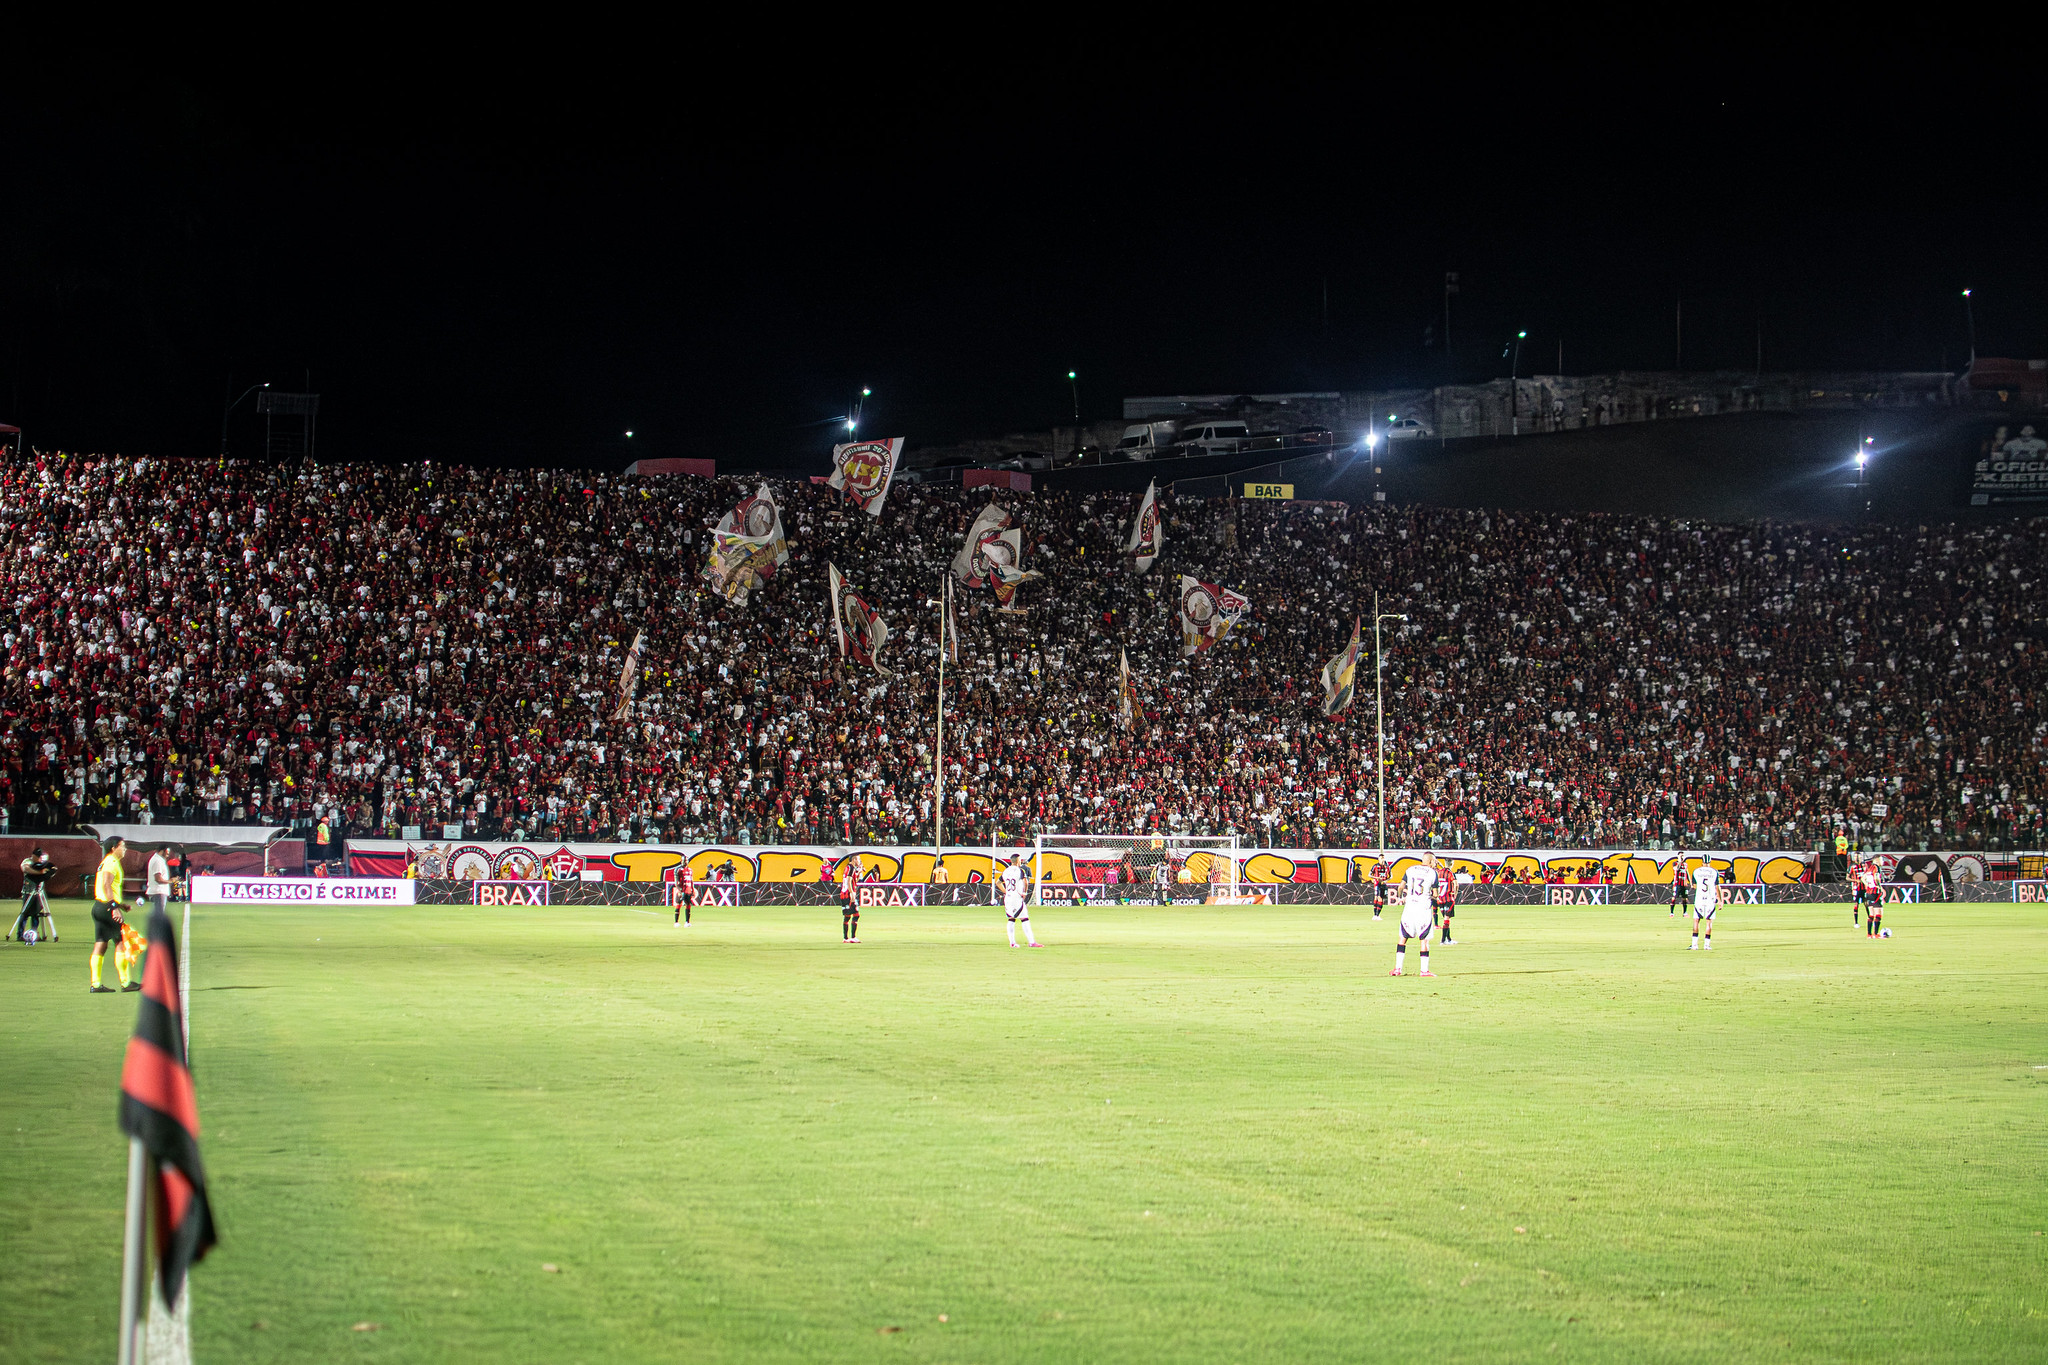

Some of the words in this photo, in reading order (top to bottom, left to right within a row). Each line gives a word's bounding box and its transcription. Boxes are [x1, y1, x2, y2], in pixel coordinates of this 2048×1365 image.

[1993, 461, 2048, 472] OFICI
[1255, 485, 1282, 497] BAR
[222, 883, 311, 899] RACISMO
[316, 882, 326, 898] É
[331, 885, 397, 899] CRIME!
[1411, 877, 1425, 896] 13
[1701, 878, 1709, 892] 5
[2018, 884, 2048, 902] BRA
[480, 885, 542, 905] BRAX
[672, 887, 732, 906] RAX
[860, 888, 918, 906] BRAX
[1043, 899, 1072, 907] SICOOB
[1086, 899, 1116, 907] SICOOB
[1551, 888, 1602, 905] BRAX
[1716, 888, 1759, 904] RAX
